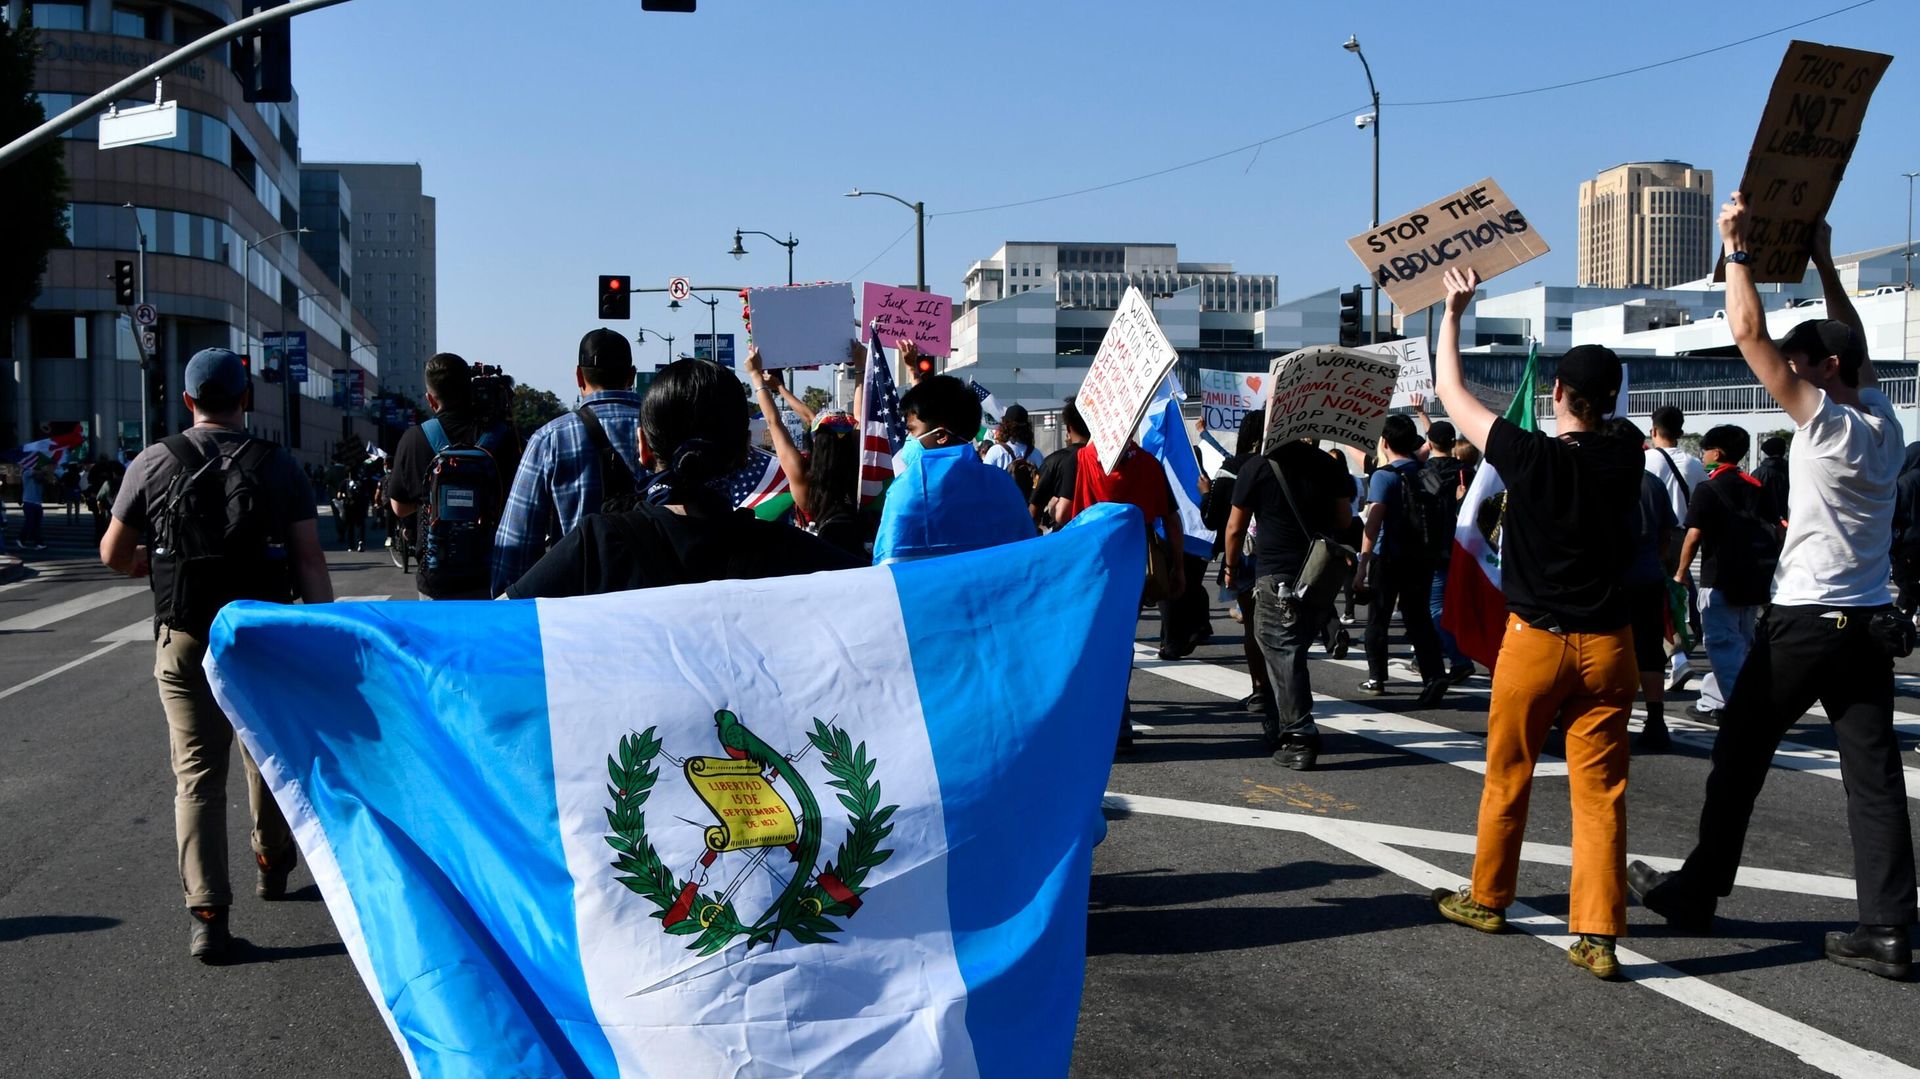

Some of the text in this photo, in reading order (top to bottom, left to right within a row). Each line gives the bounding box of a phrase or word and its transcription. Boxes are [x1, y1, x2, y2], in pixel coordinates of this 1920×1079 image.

[1794, 54, 1869, 94] THIS IS
[1785, 93, 1847, 132] NOT
[1764, 178, 1809, 206] IT IS
[1367, 187, 1494, 253] STOP THE
[1376, 209, 1528, 287] ABDUCTIONS
[914, 301, 943, 316] ICE
[1130, 298, 1163, 364] WORKERS
[1116, 312, 1153, 380] ACTION TO
[1107, 327, 1144, 398] SMASH THE
[1316, 356, 1398, 379] WORKERS
[1091, 363, 1115, 406] MACHINE
[1097, 345, 1137, 422] DEPORTATION
[1202, 371, 1243, 390] KEEP
[1273, 381, 1339, 406] NATIONAL
[1344, 385, 1390, 407] GUARD
[1202, 391, 1251, 408] FAMILIES
[1272, 393, 1385, 423] OUT NOW!
[1272, 409, 1369, 433] STOP THE
[1265, 424, 1377, 450] DEPORTATIONS
[708, 780, 762, 791] LIBERTAD
[723, 805, 784, 817] SEPTIEMBRE
[743, 794, 760, 805] DE
[745, 820, 760, 828] DE
